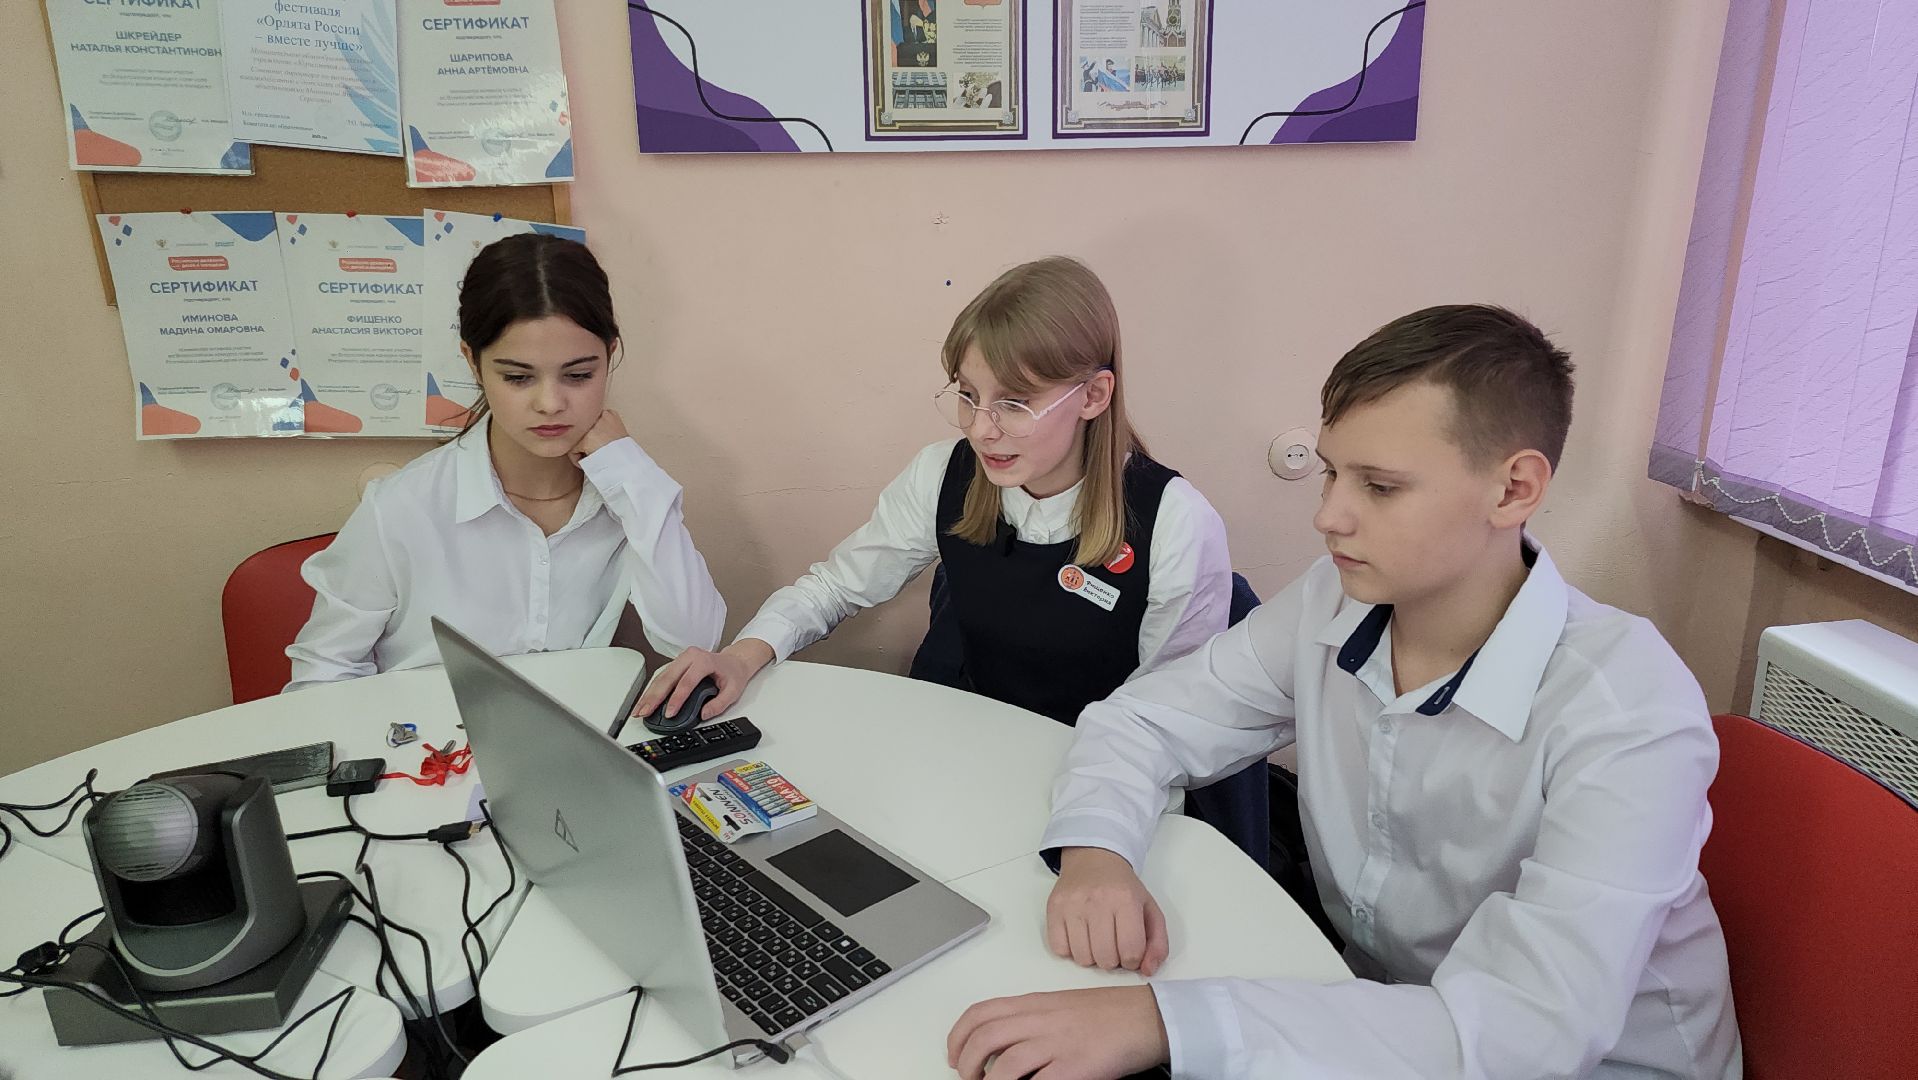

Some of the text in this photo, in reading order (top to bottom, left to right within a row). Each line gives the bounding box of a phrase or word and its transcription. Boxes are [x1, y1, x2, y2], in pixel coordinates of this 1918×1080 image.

[274, 0, 341, 17] фестиваля
[256, 14, 361, 36] «Орлята России
[422, 17, 530, 30] СЕРТИФИКАТ
[115, 30, 182, 42] ШКРЕЙДЕР
[267, 34, 311, 46] вместе
[315, 39, 363, 51] лучше»
[71, 42, 222, 57] НАТАЛЬЯ КОНСТАНТИНОВН
[449, 53, 513, 63] ШАРИПОВА
[437, 65, 529, 76] АННА АРТЁМОВНА
[150, 280, 258, 294] СЕРТИФИКАТ
[318, 281, 423, 295] СЕРТИФИКАТ
[181, 313, 239, 323] ИМИНОВА
[346, 315, 402, 325] ФИЩЕНКО
[159, 325, 265, 336] МАДИНА ОМАРОВНА
[311, 327, 423, 336] АНАСТАСИЯ ВИКТОРОВ
[709, 787, 753, 826] SONNEN
